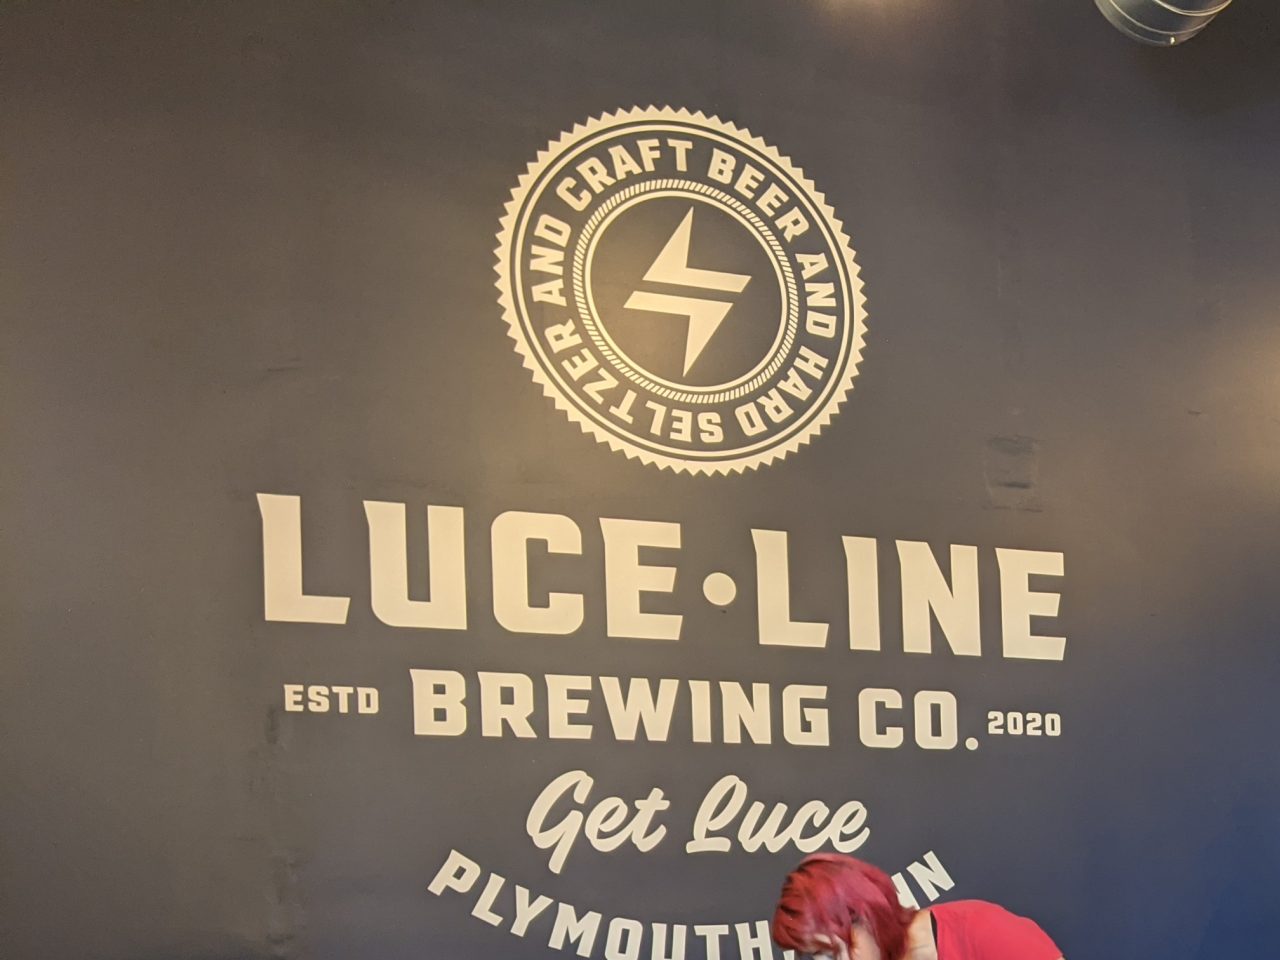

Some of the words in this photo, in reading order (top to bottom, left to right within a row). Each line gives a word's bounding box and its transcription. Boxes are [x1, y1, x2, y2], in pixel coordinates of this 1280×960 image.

[555, 138, 693, 212] CRAFT
[707, 147, 810, 243] BEER
[529, 213, 572, 307] AND
[795, 252, 837, 339] AND
[543, 318, 724, 443] SELTZER
[734, 345, 829, 437] HARD
[283, 683, 380, 714] ESTD
[410, 668, 830, 747] BREWING
[858, 687, 980, 751] CO.
[987, 710, 1062, 738] 2020
[525, 769, 670, 874] Get
[686, 774, 870, 854] Luce
